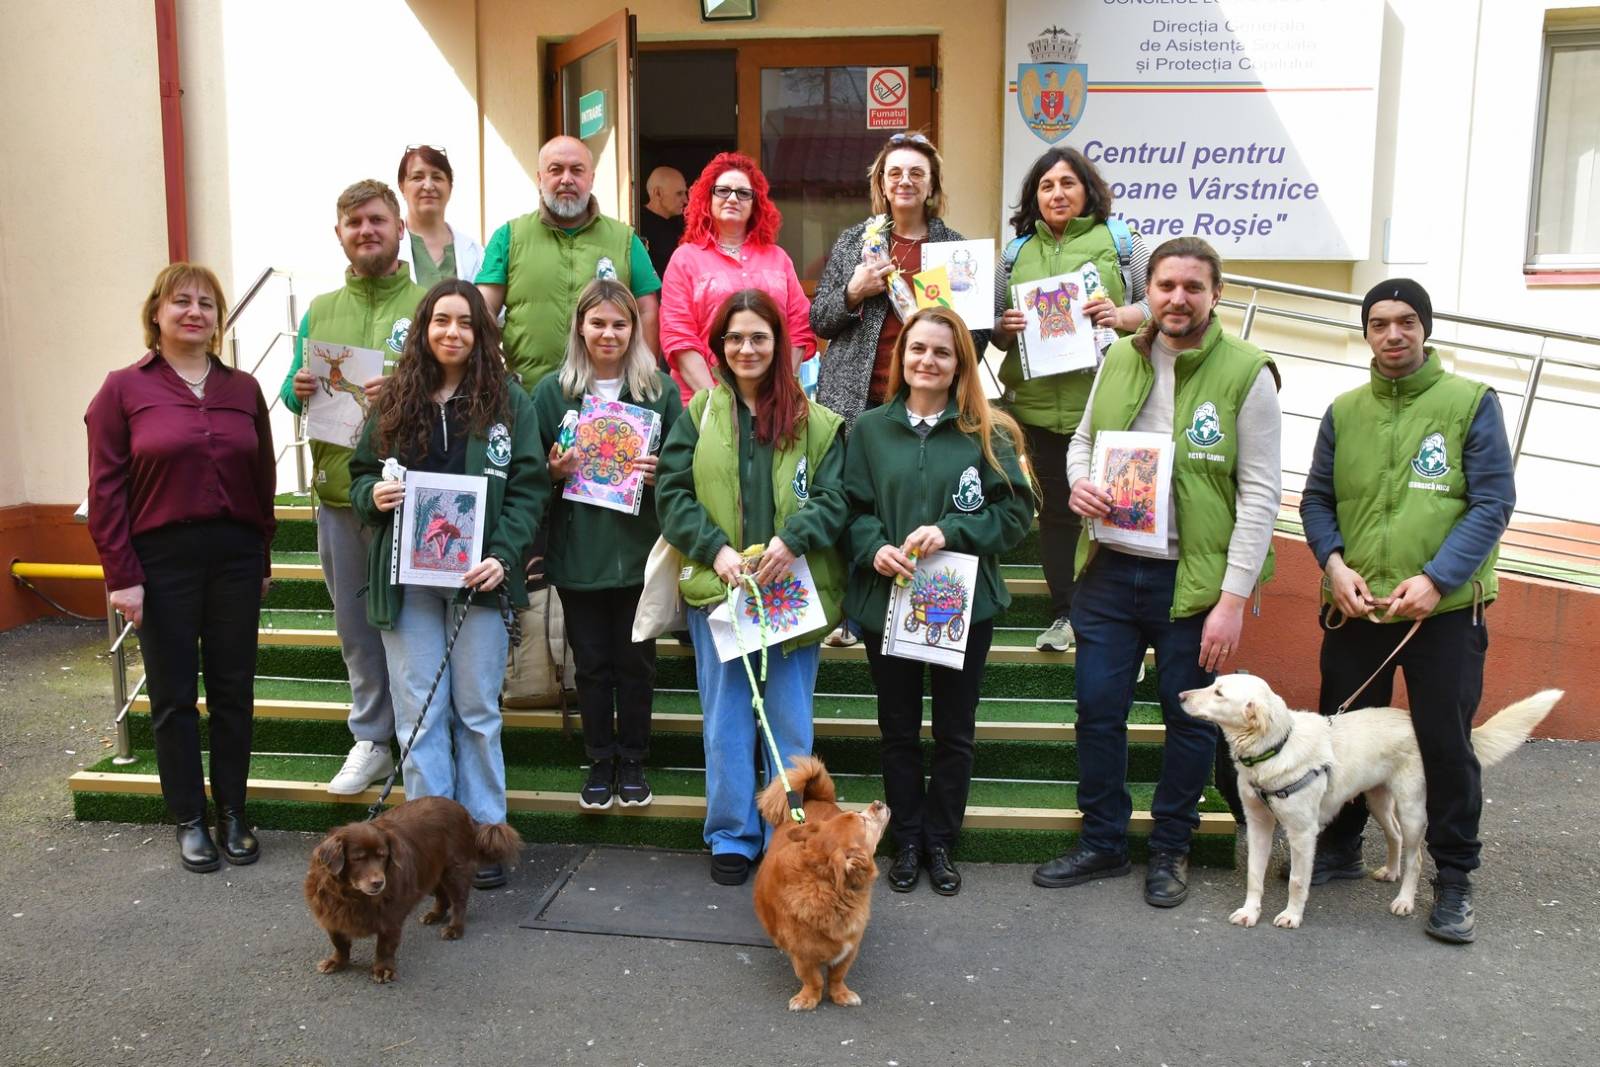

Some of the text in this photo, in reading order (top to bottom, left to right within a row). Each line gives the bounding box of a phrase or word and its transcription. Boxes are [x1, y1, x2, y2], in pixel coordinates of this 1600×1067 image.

[1140, 39, 1161, 51] de
[1083, 140, 1286, 170] Centrul pentru
[1188, 177, 1320, 200] Vârstnice
